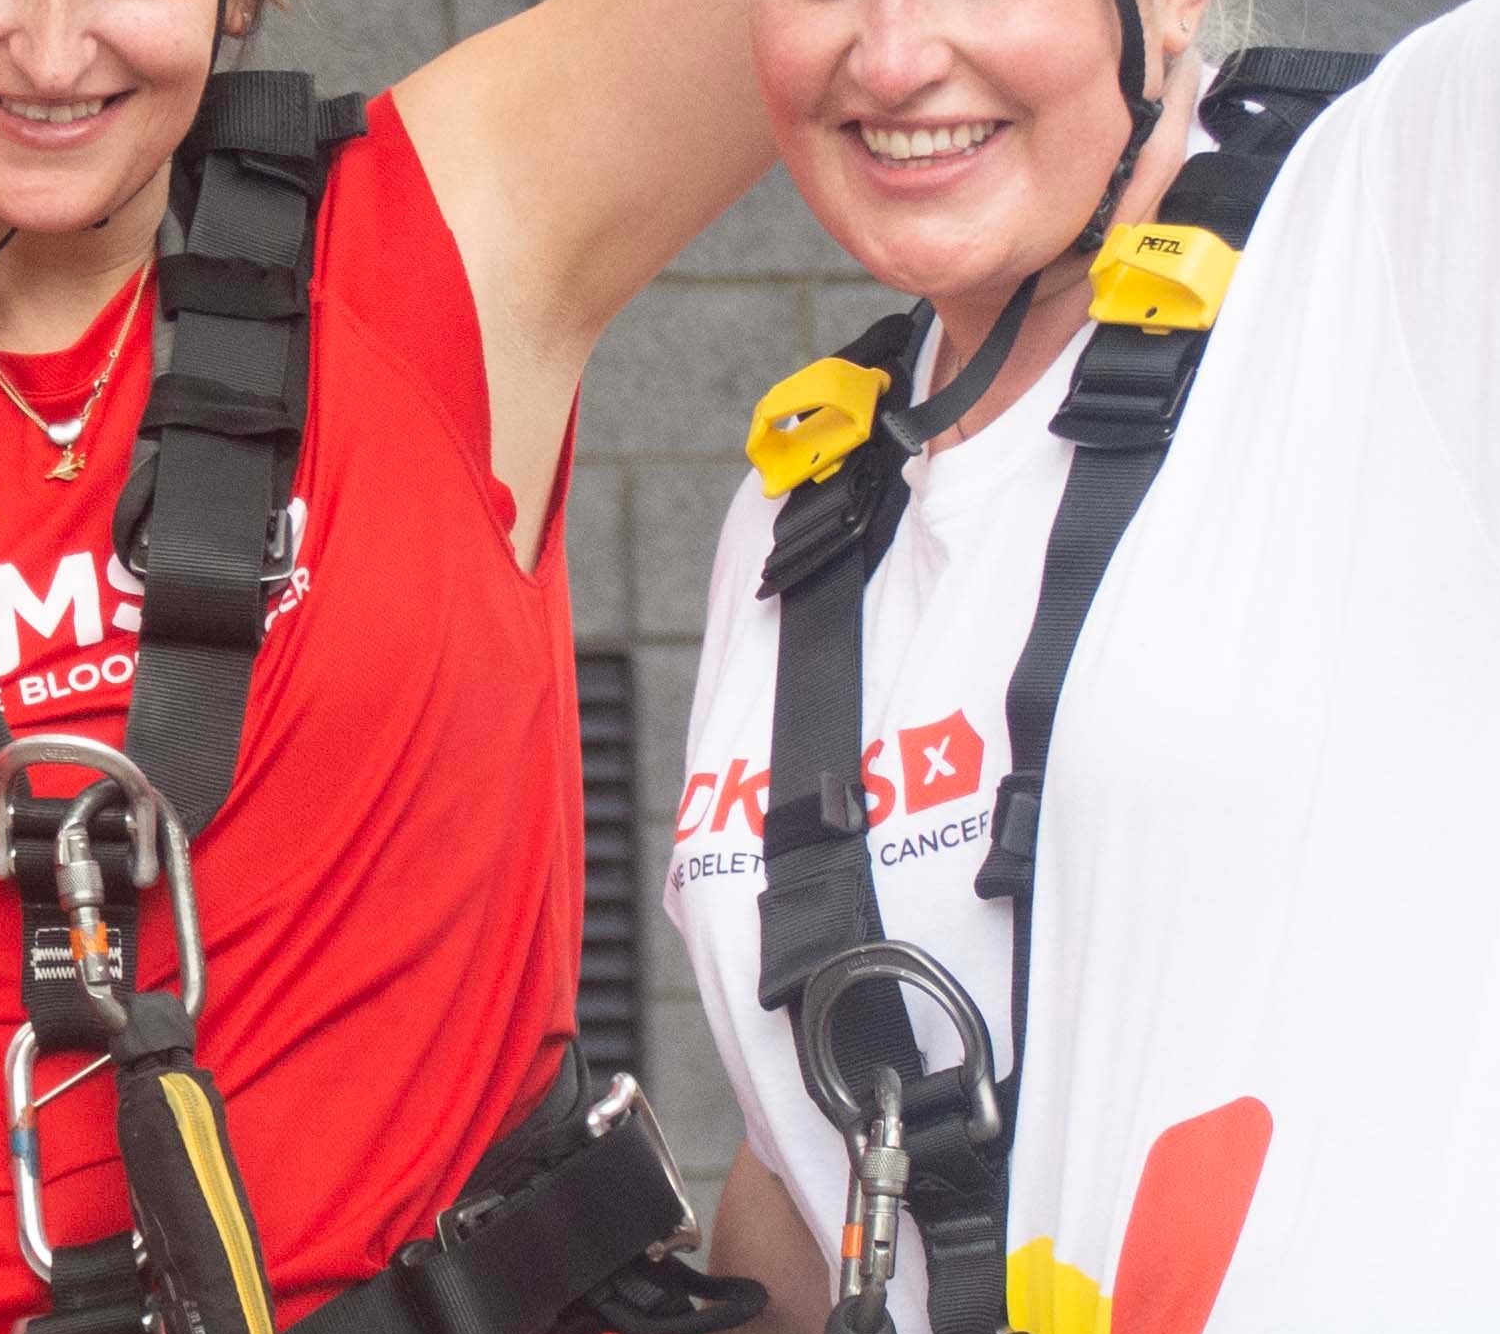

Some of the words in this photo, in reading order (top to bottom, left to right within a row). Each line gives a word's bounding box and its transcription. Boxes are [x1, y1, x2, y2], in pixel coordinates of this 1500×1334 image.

[1136, 235, 1184, 255] PETZL
[20, 652, 139, 706] BLOO
[674, 738, 896, 844] DKS
[689, 852, 766, 881] DELET
